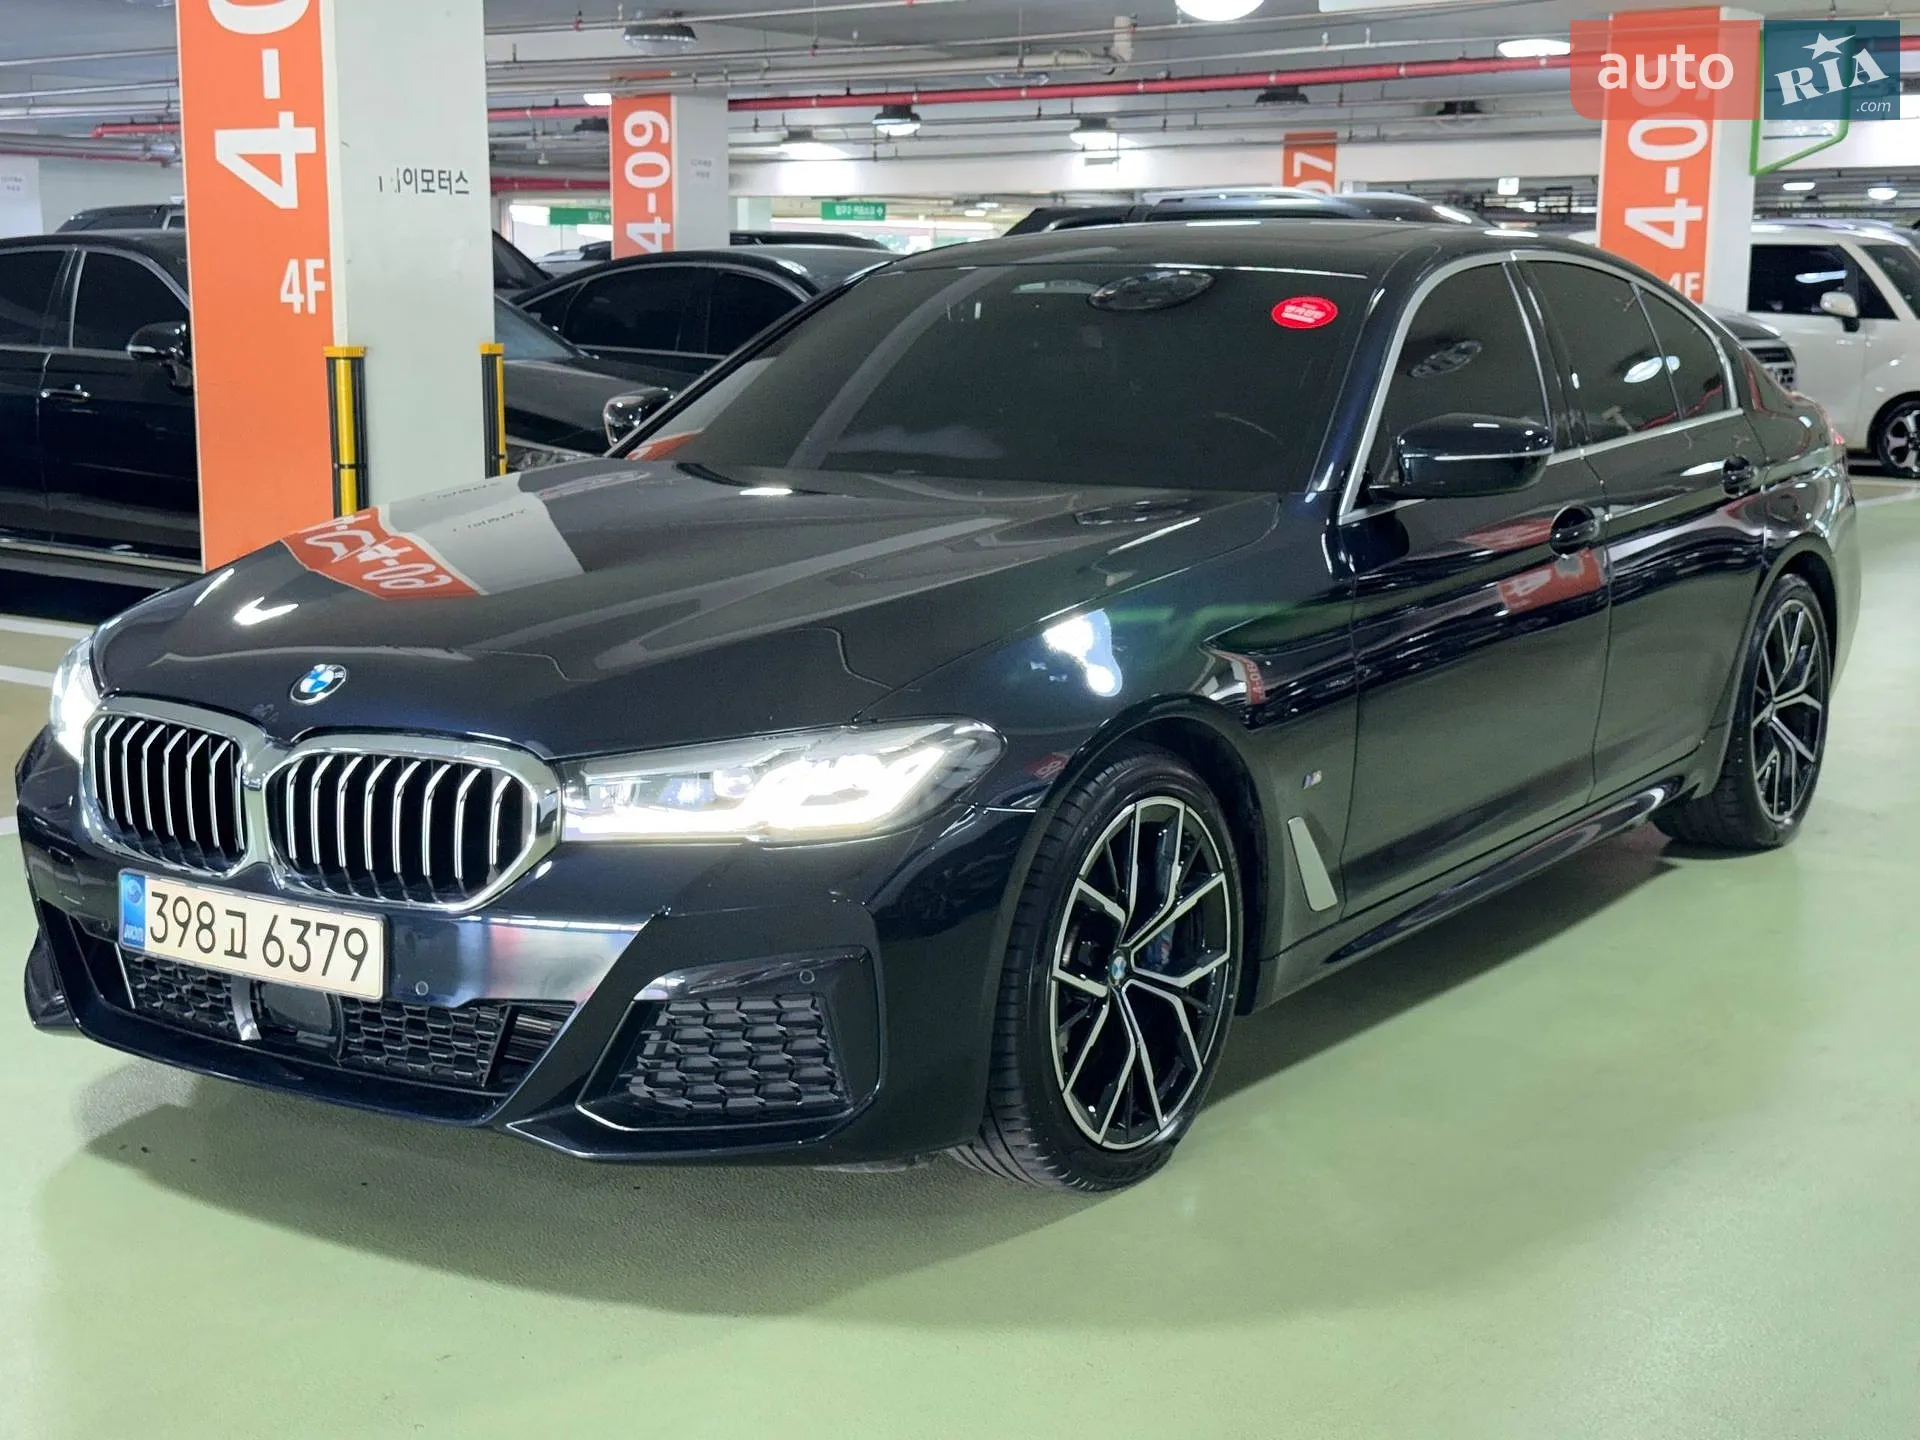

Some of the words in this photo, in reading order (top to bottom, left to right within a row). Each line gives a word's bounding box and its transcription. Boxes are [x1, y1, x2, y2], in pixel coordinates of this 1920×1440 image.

[624, 110, 671, 253] 4-09
[280, 259, 326, 314] 4F
[150, 891, 248, 960] 398고
[262, 914, 369, 982] 6379
